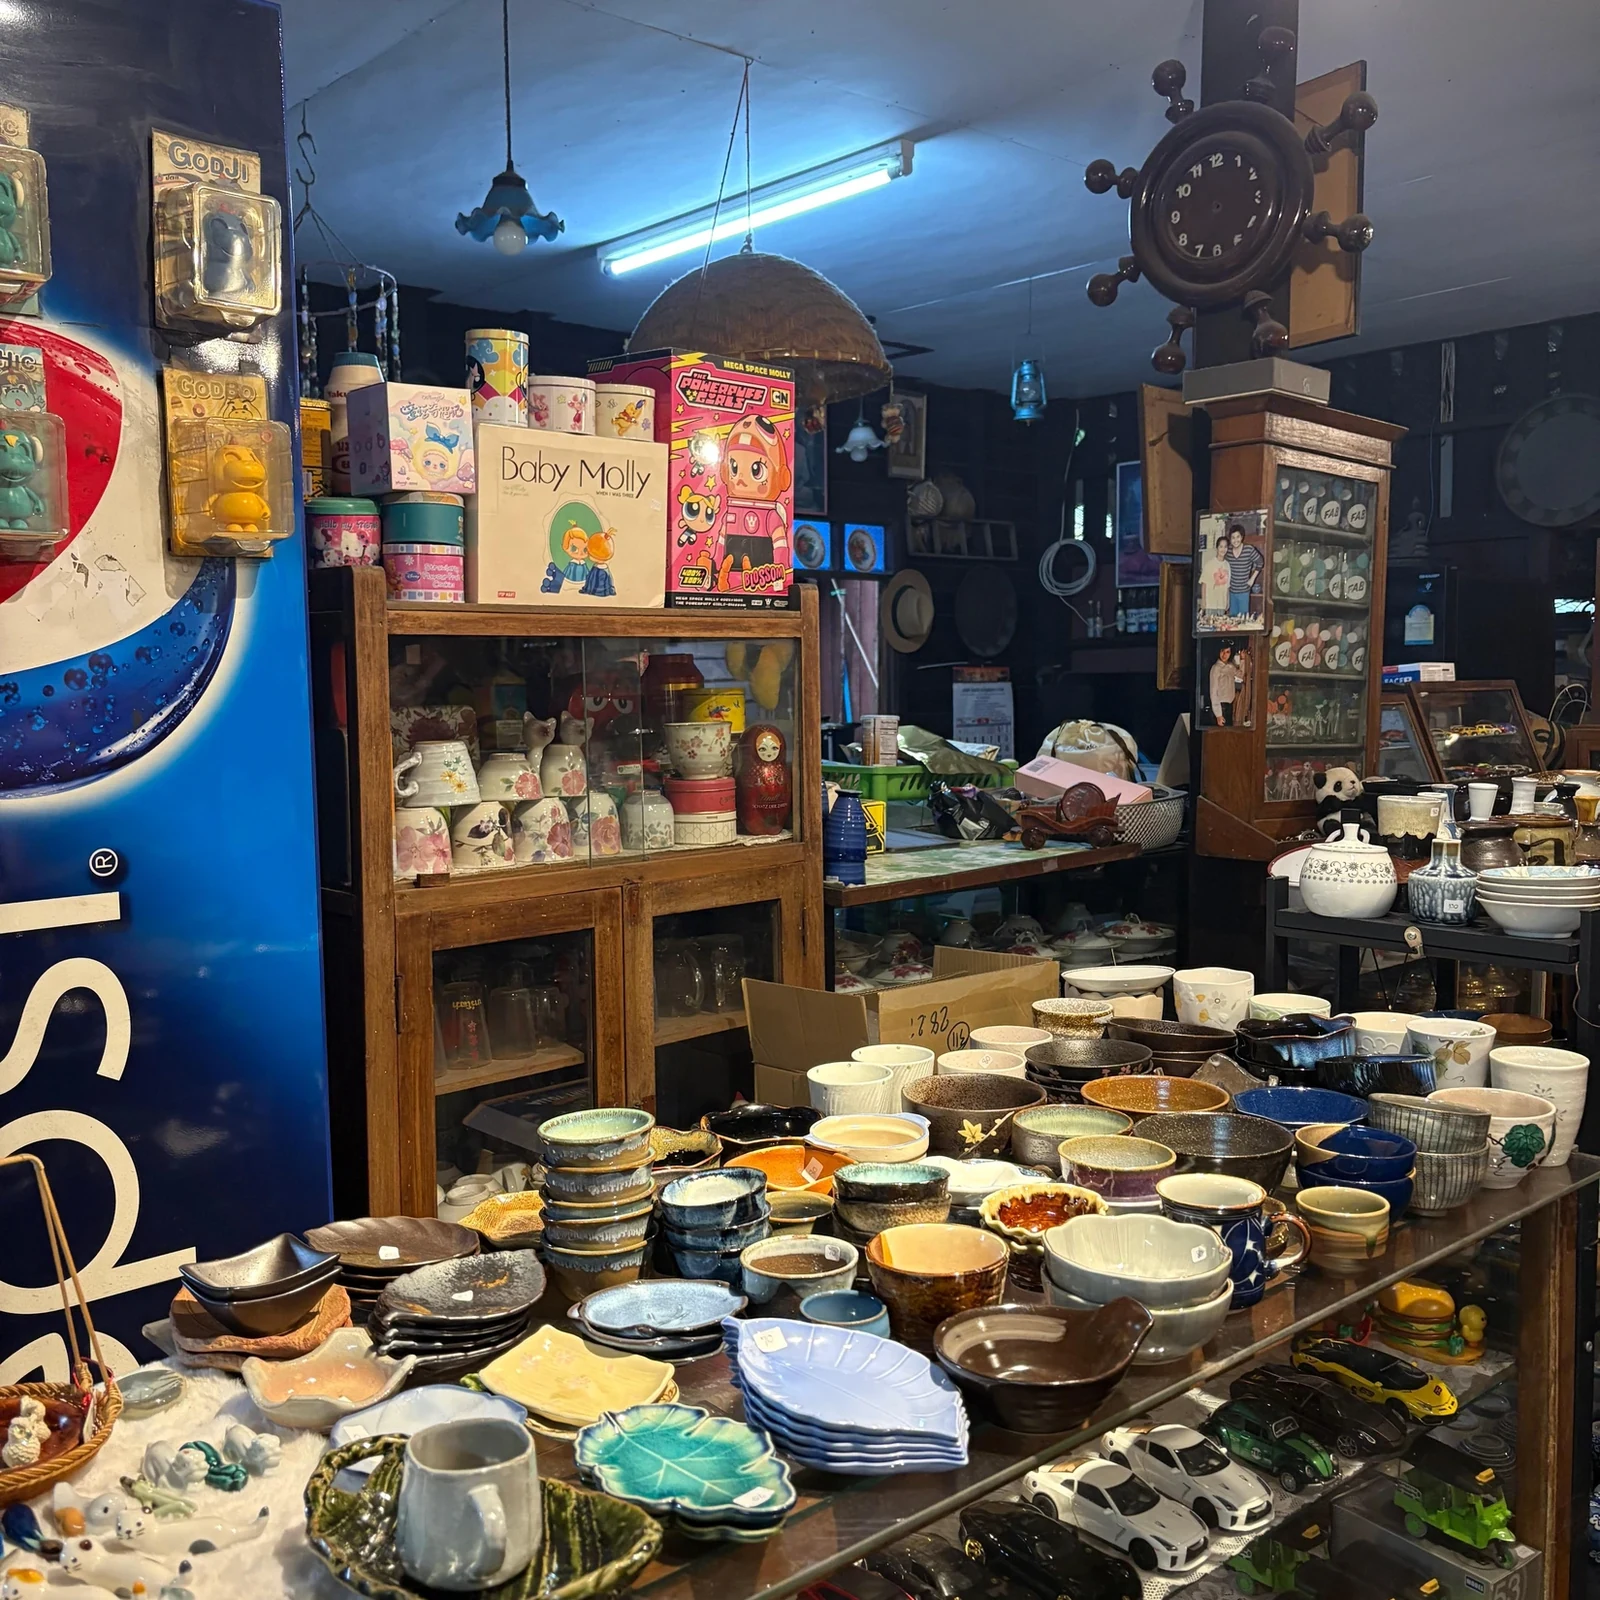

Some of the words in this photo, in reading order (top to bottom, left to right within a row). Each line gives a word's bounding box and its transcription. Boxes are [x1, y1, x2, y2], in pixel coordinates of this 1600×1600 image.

[168, 141, 247, 182] GODJI
[1209, 153, 1224, 168] 12
[1234, 154, 1242, 168] 1
[1190, 163, 1203, 178] 11
[1176, 183, 1191, 198] 10
[1171, 210, 1181, 224] 9
[1178, 233, 1188, 246] 8
[1194, 244, 1204, 258] 7
[1213, 244, 1222, 257] 6
[692, 372, 707, 380] THE
[723, 360, 744, 371] MEGA
[745, 364, 768, 375] SPACE
[769, 368, 791, 379] MOLLY
[177, 374, 256, 402] GODBO
[680, 376, 764, 400] POWERPUFF
[695, 390, 745, 409] GIRLS
[772, 390, 789, 405] CN
[502, 446, 570, 491] Baby
[579, 459, 651, 499] Molly
[1323, 507, 1339, 520] FAB
[1350, 509, 1366, 522] FAB
[743, 566, 785, 589] BLOSSOM
[1347, 580, 1365, 593] FAB
